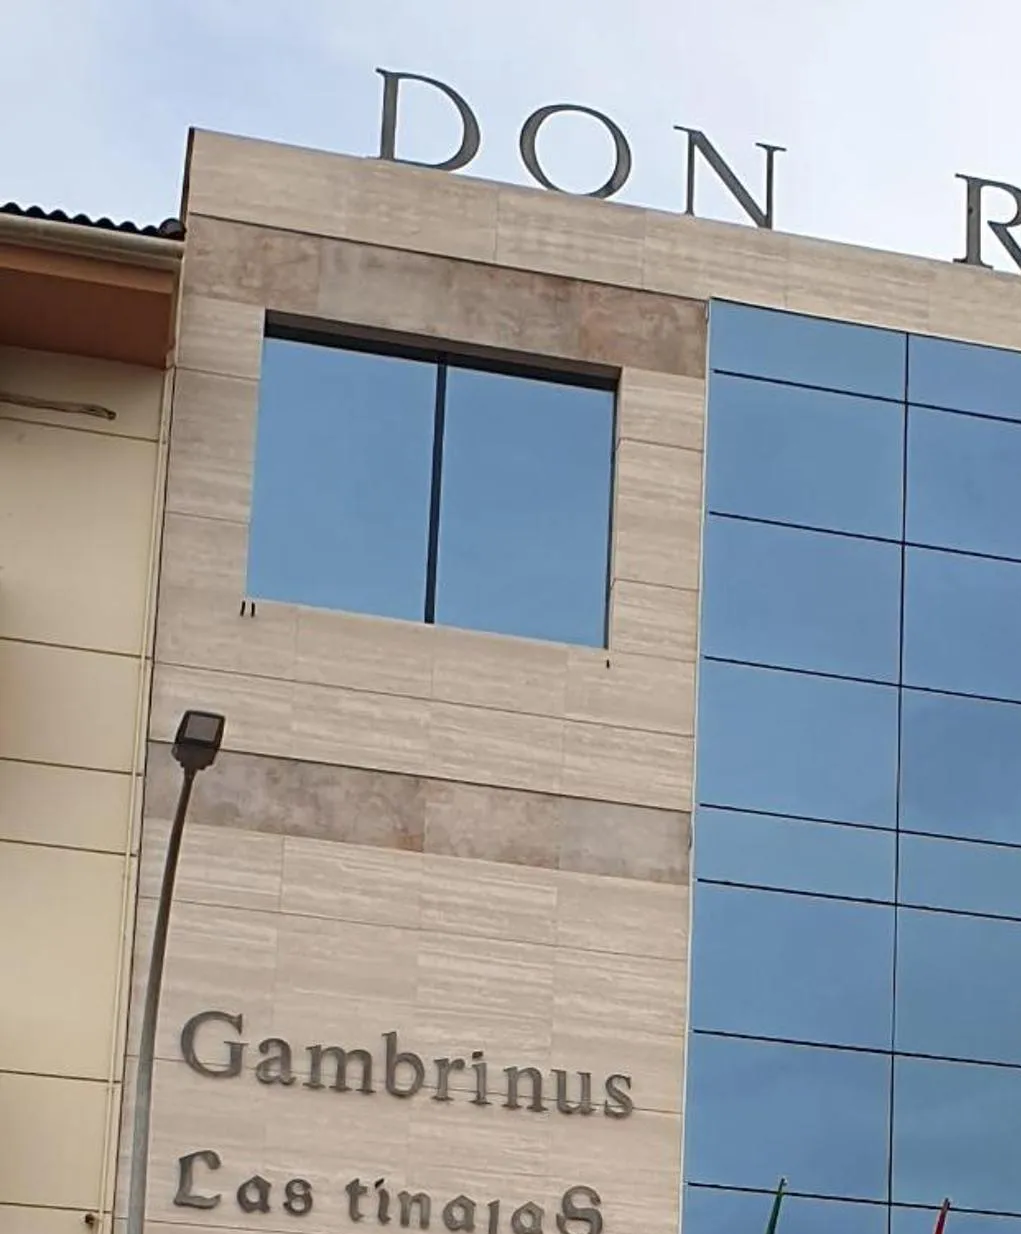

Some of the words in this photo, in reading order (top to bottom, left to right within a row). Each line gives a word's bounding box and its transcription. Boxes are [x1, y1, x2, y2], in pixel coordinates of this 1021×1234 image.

[375, 67, 787, 231] DON
[181, 1010, 634, 1120] Gambrinus
[173, 1149, 314, 1217] Las
